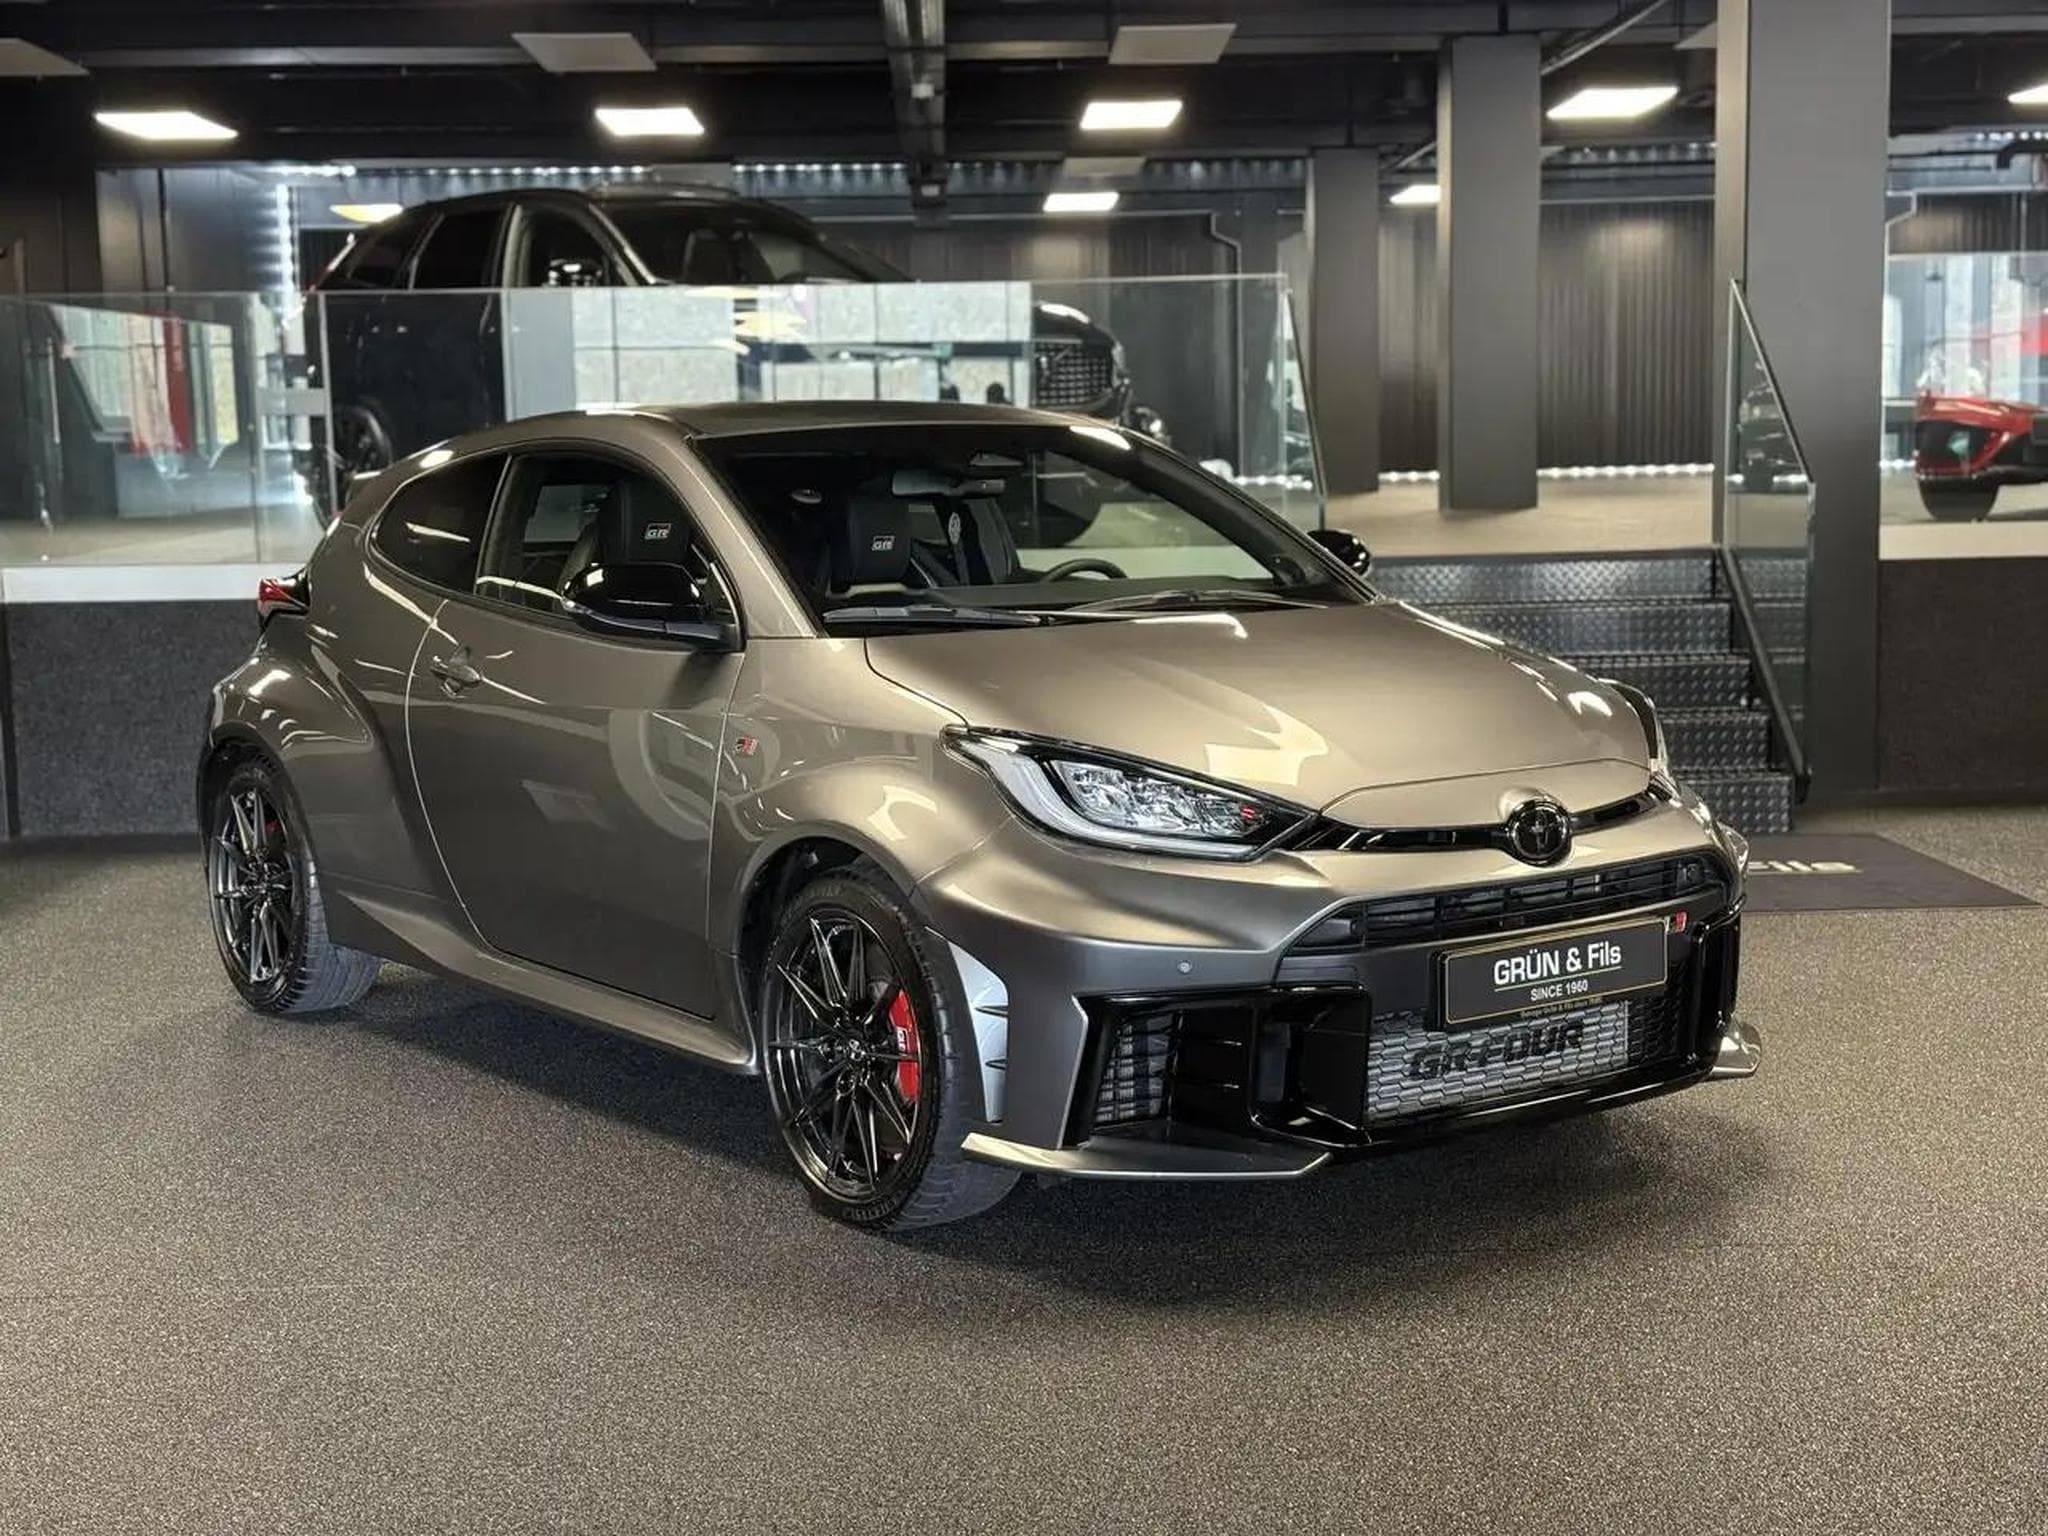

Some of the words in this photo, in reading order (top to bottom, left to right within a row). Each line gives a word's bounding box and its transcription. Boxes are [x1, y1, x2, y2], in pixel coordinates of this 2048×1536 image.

[1493, 948, 1560, 985] GRÜN
[1566, 947, 1582, 972] &
[1587, 940, 1622, 969] Fils
[1530, 983, 1563, 1001] SINCE
